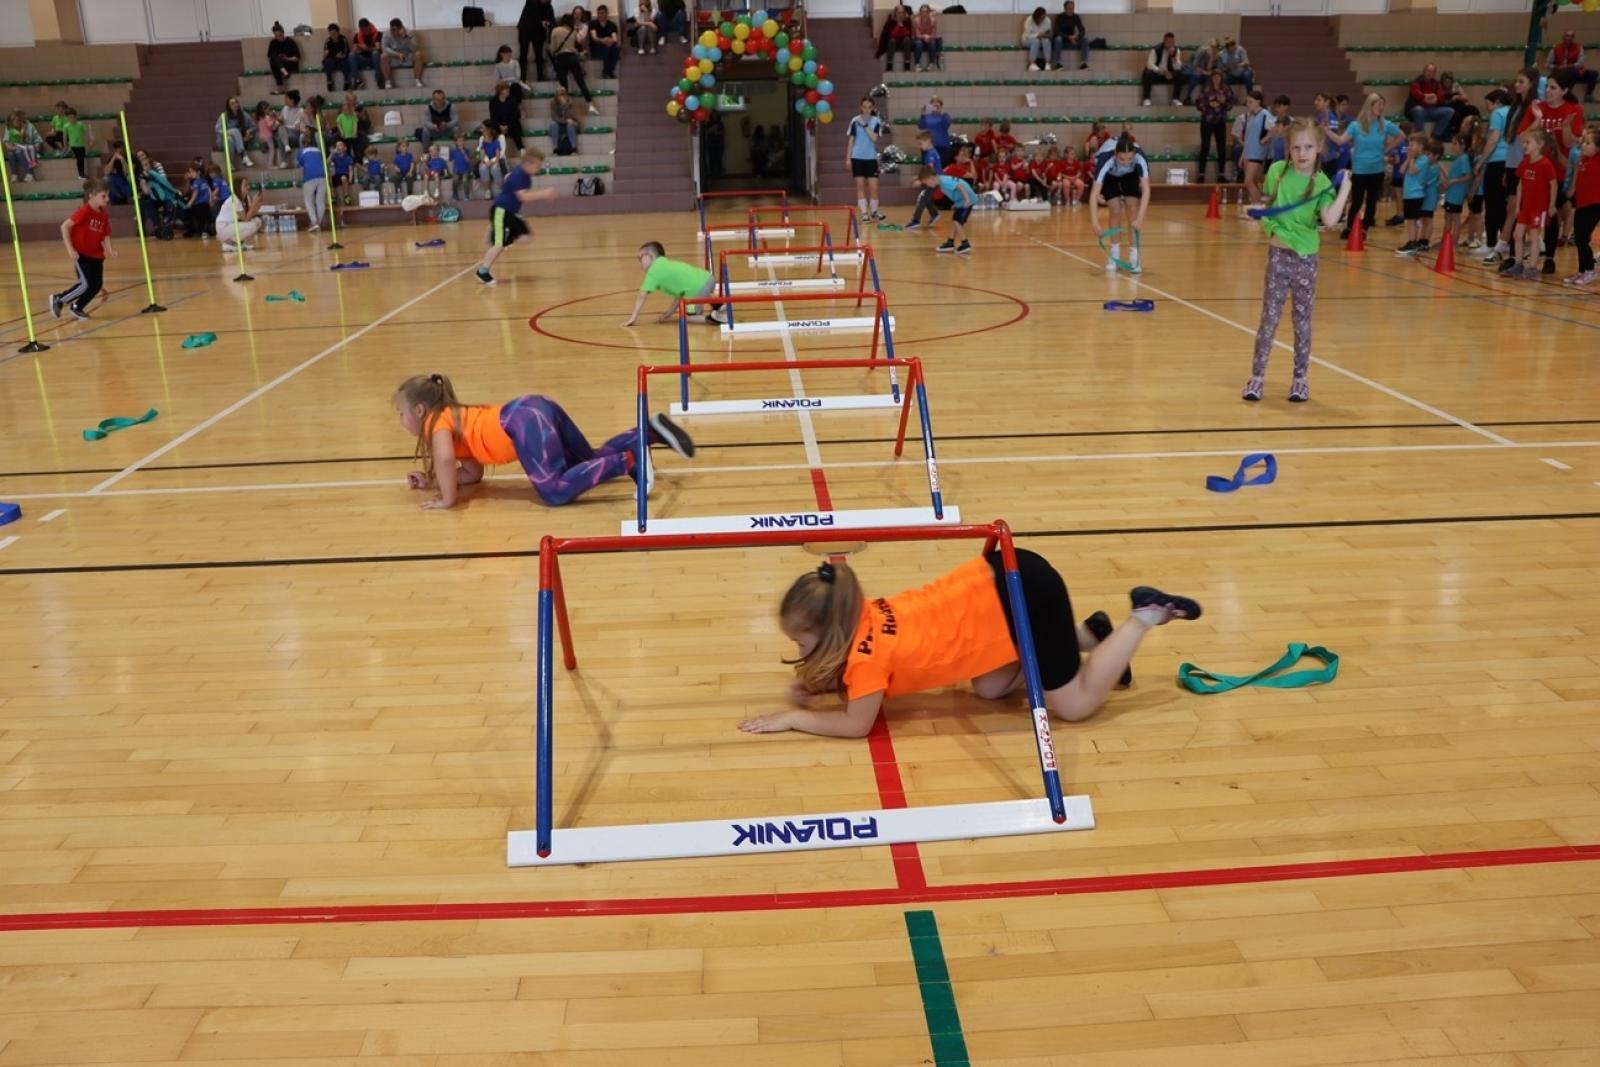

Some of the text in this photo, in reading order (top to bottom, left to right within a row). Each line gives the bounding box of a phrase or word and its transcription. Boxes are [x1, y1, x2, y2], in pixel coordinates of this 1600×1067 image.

[762, 399, 822, 409] POLANIK
[750, 514, 834, 529] POLANIK
[731, 816, 879, 847] POLANIK
